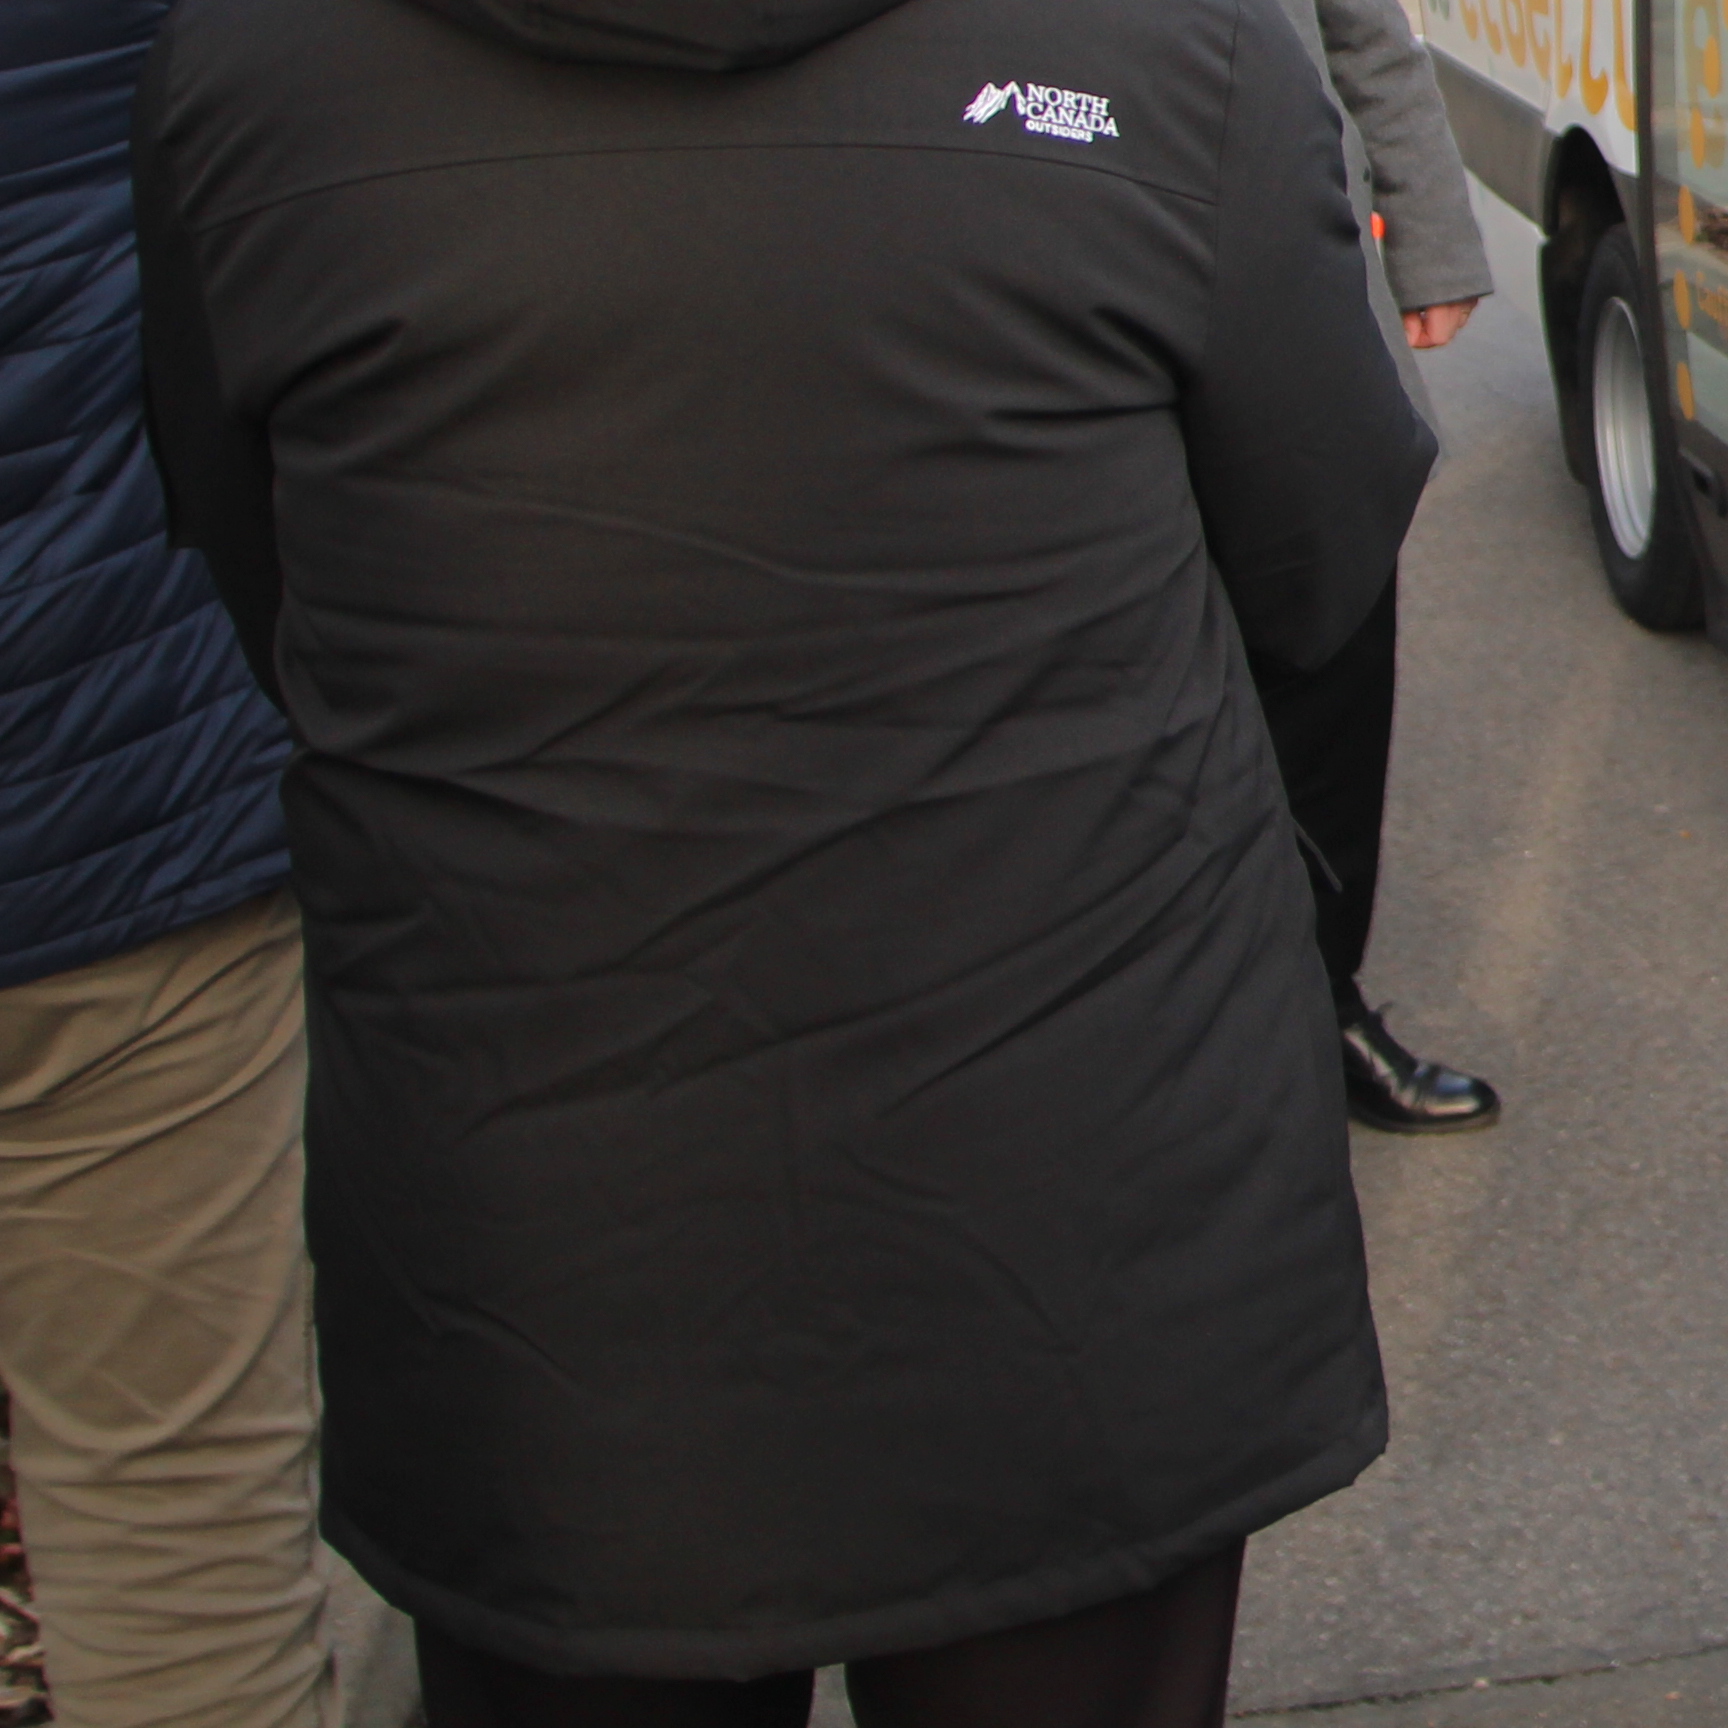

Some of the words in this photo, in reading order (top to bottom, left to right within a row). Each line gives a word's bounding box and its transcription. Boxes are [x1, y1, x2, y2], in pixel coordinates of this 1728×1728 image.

[1026, 82, 1110, 116] NORTH
[1024, 118, 1093, 143] OUTSIDERS
[1026, 102, 1120, 138] CANADA
